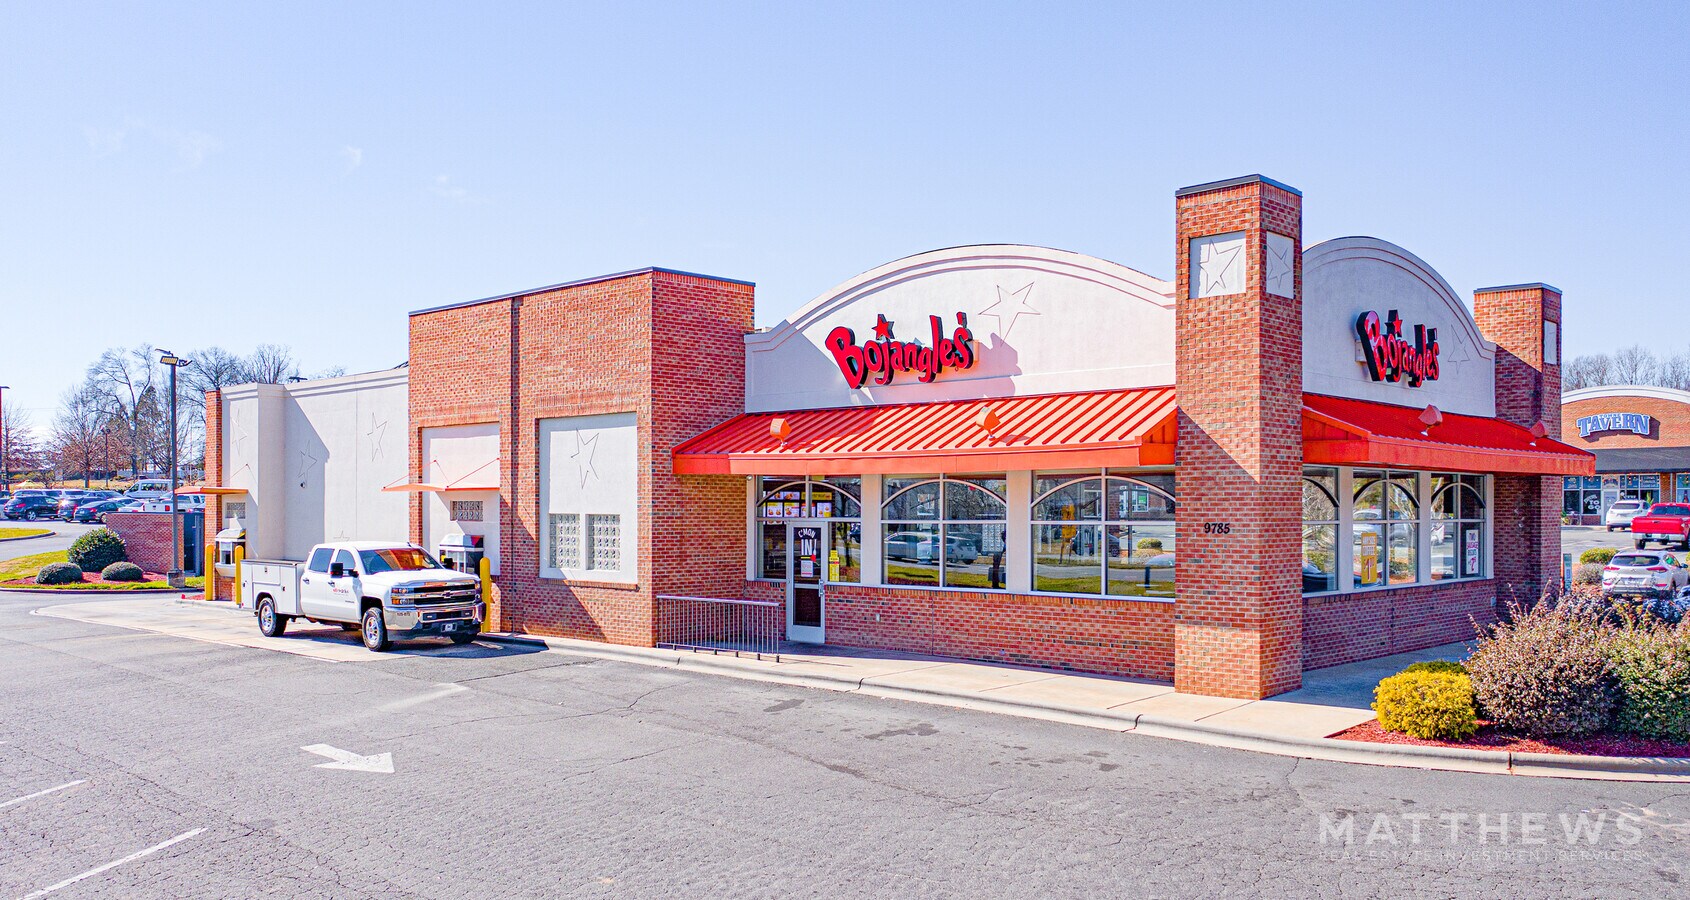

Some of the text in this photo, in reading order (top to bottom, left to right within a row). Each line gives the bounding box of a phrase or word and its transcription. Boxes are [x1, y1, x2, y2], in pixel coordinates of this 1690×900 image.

[1577, 413, 1650, 437] TAVERN
[797, 528, 816, 538] C'MON
[1204, 522, 1230, 534] 9785
